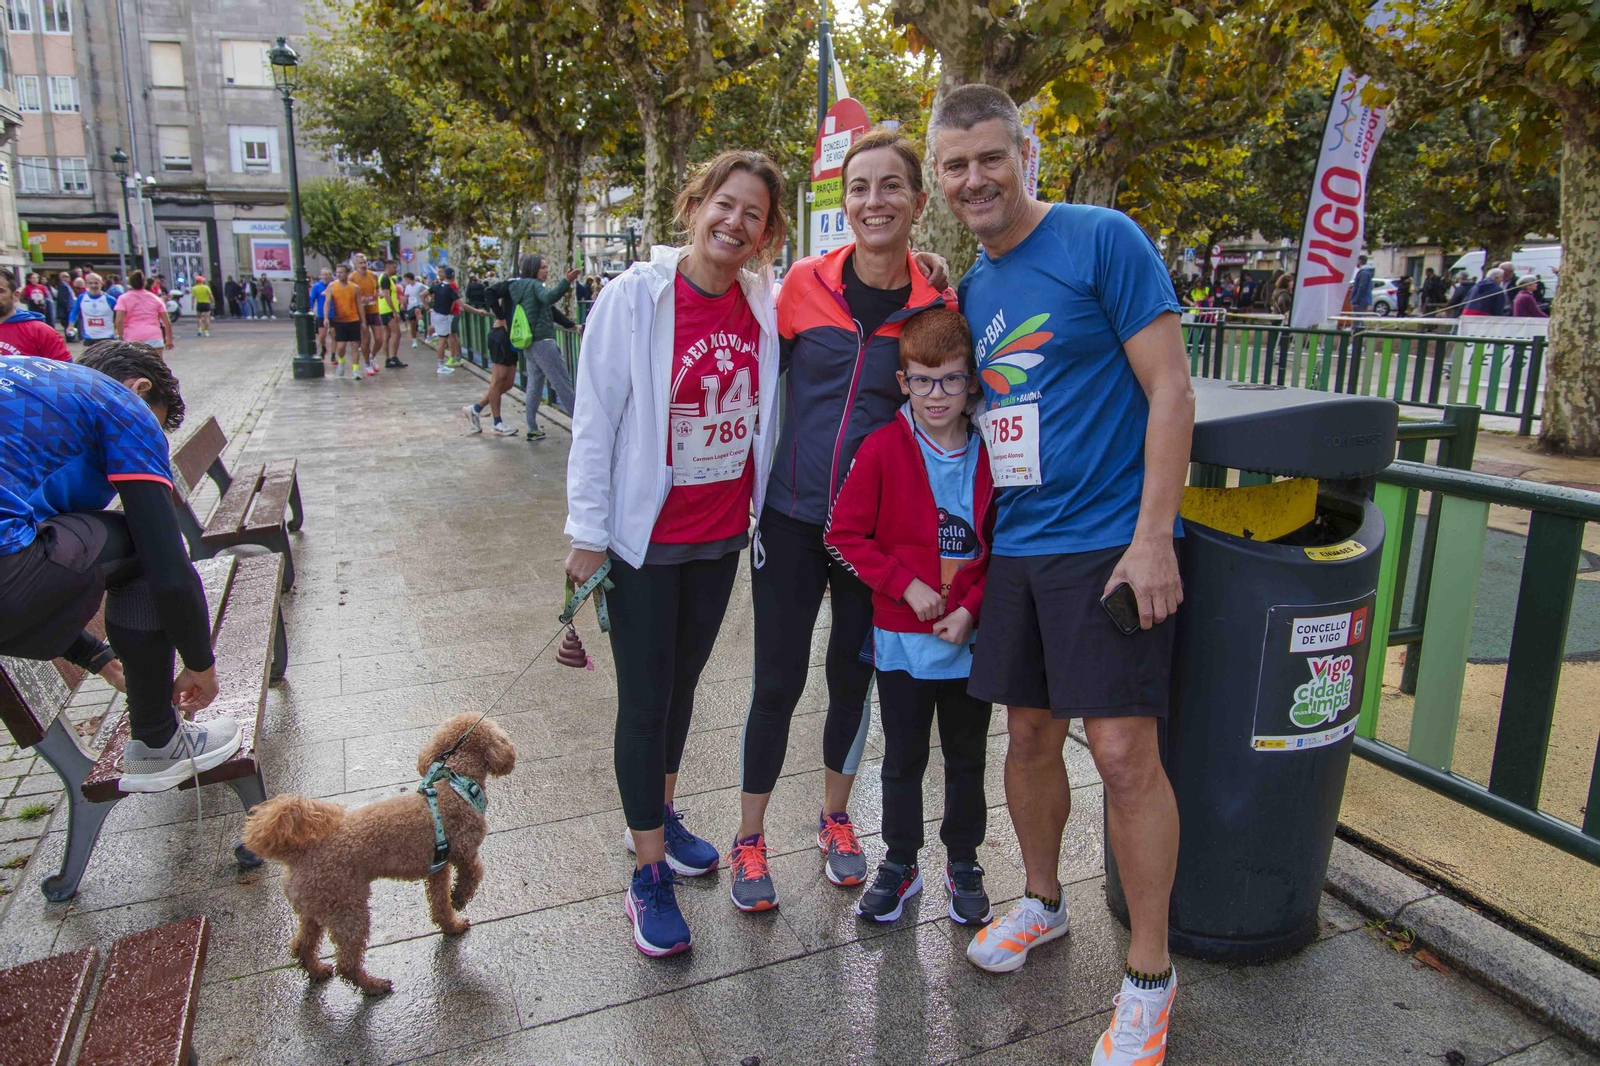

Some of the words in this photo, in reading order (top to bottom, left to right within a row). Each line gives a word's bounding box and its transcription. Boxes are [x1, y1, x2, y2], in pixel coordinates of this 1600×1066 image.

[823, 139, 849, 152] CONCELLO
[826, 154, 833, 162] DE
[834, 150, 845, 160] VIGO
[816, 182, 838, 193] PARQUE
[1303, 166, 1361, 287] VIGO
[985, 308, 1007, 346] BAY
[682, 339, 708, 367] #EU
[701, 366, 753, 416] 14
[703, 416, 747, 447] 786
[991, 415, 1023, 445] 785
[714, 452, 729, 461] Lopez
[937, 525, 966, 538] rella
[938, 537, 963, 551] licia
[1320, 546, 1354, 557] ENVASES
[1297, 620, 1347, 634] CONCELLO
[1302, 635, 1316, 645] DE
[1319, 632, 1340, 643] VIGO
[1312, 659, 1351, 682] Vigo
